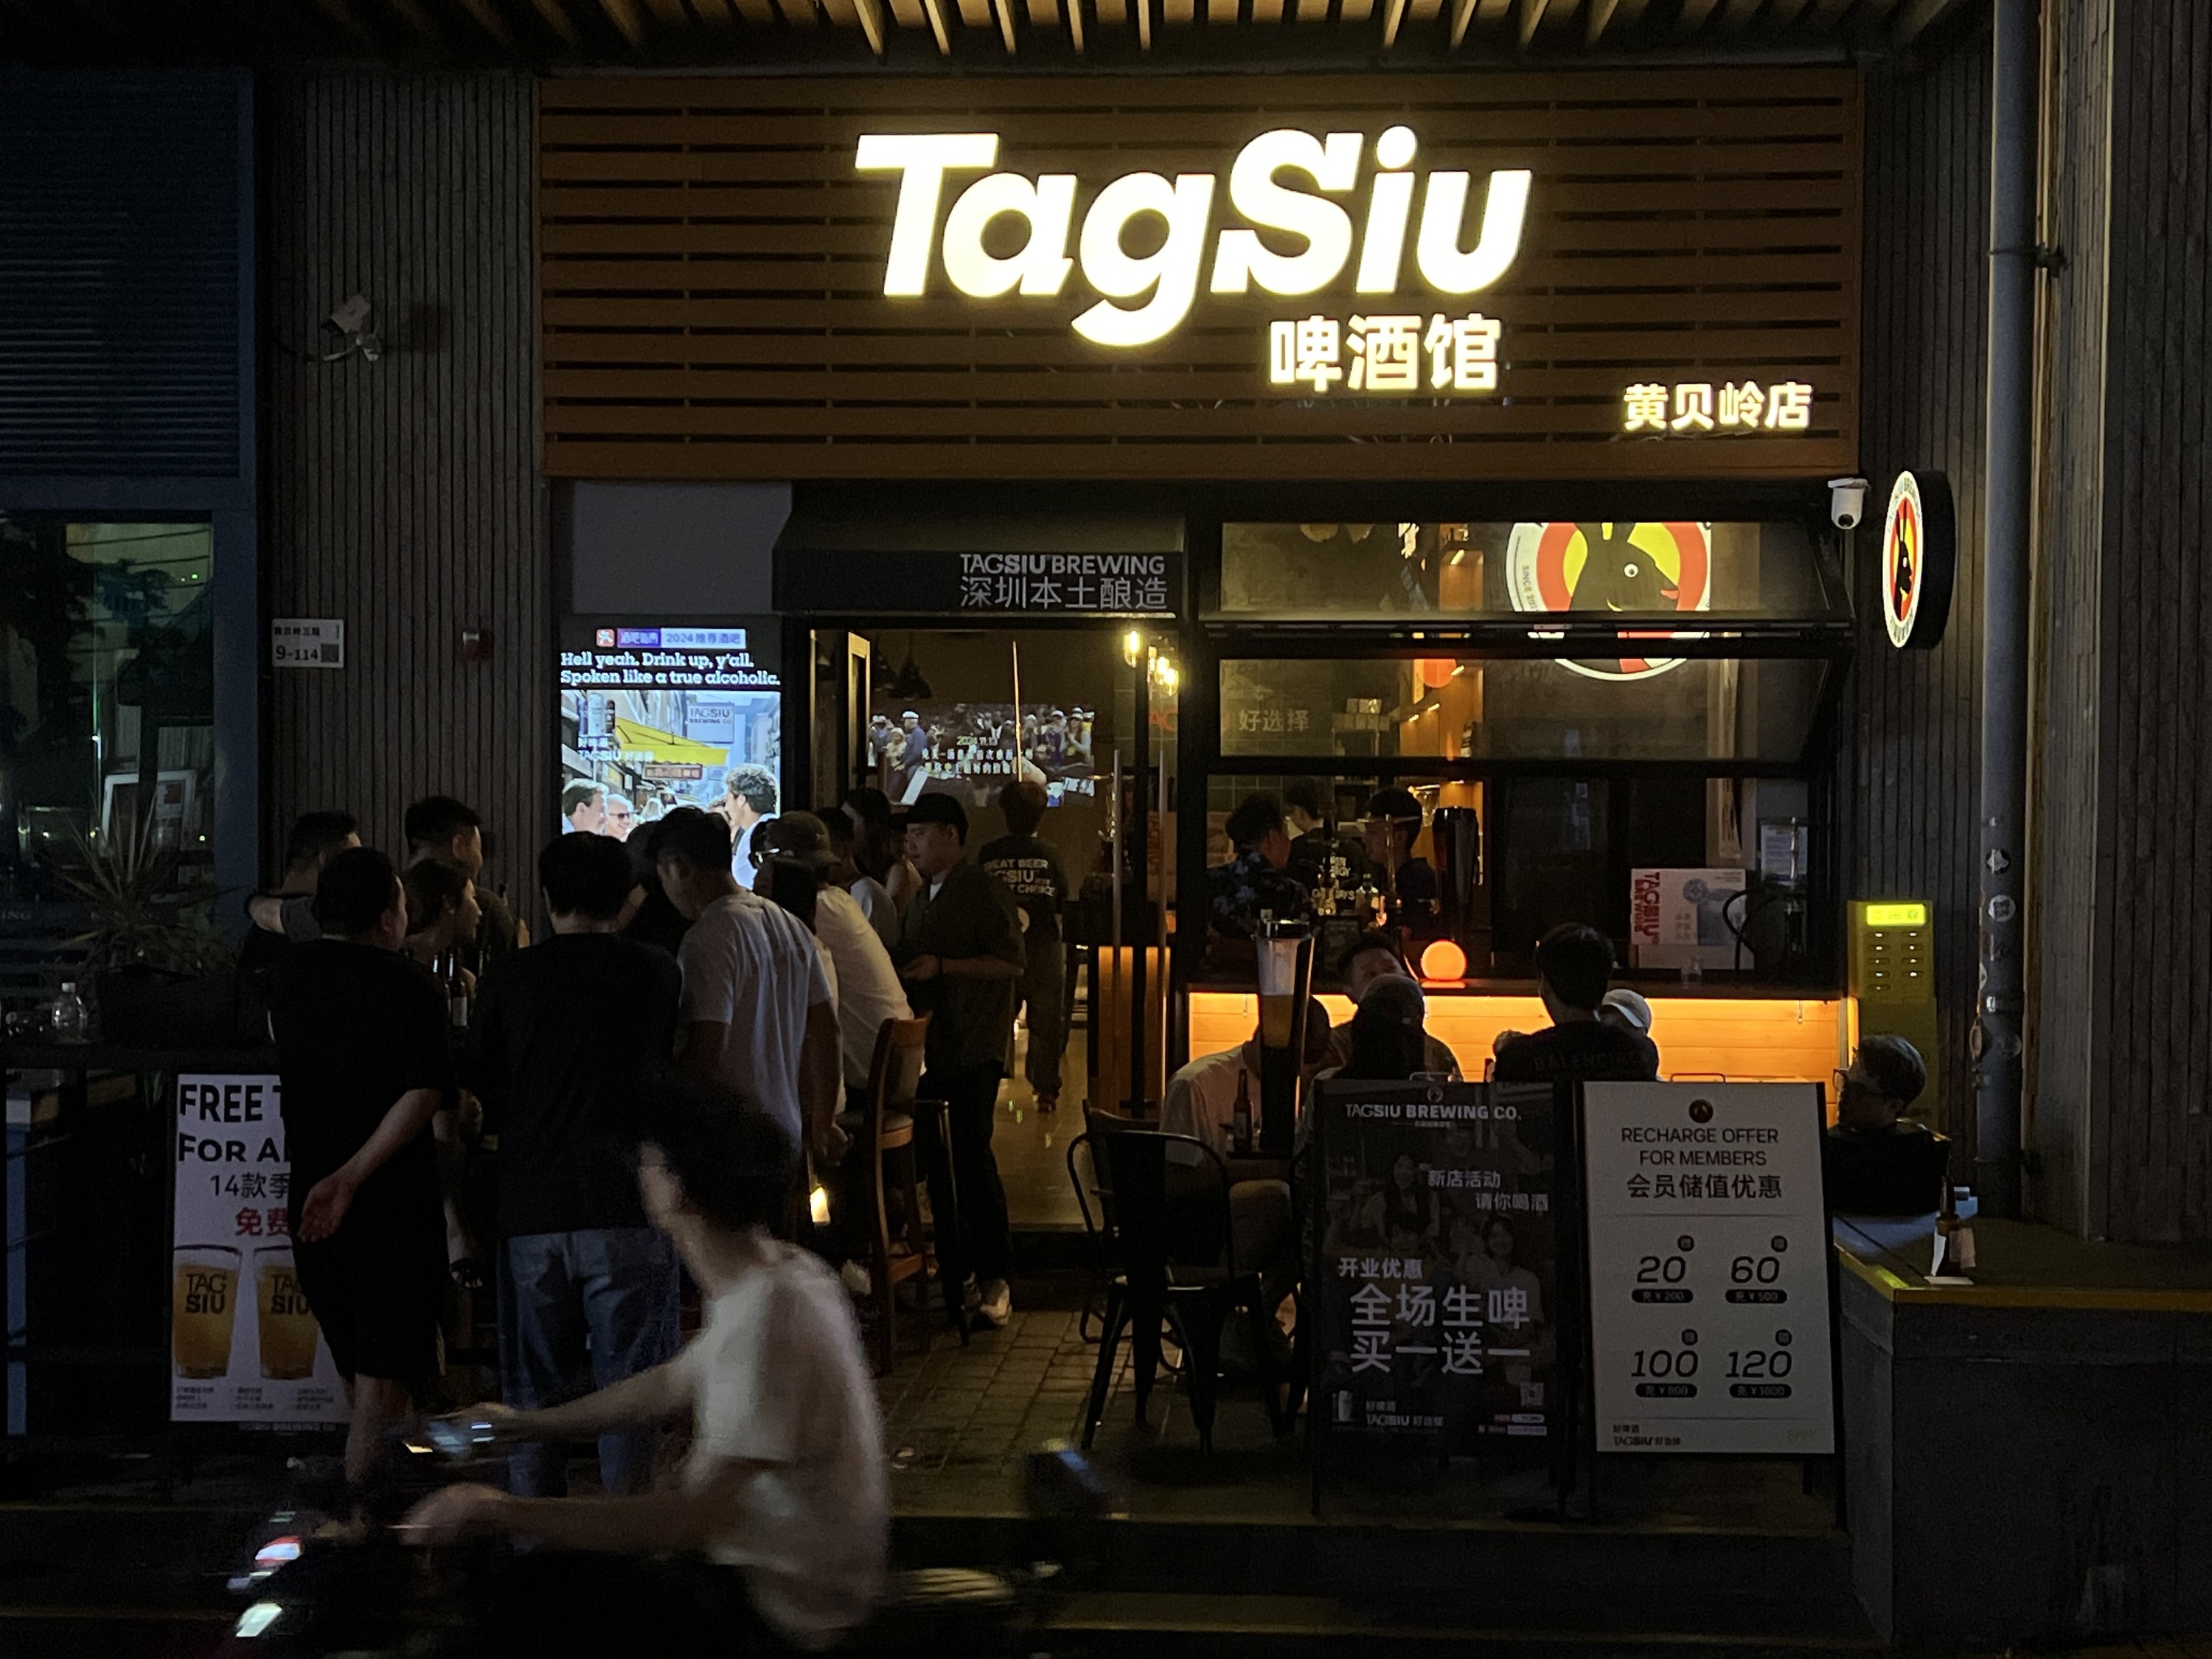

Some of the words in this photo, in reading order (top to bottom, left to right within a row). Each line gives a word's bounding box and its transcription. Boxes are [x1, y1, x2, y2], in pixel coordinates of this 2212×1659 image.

[855, 125, 1532, 347] TagSiu
[1269, 313, 1501, 392] 啤酒馆
[1624, 380, 1812, 431] 黄贝岭店
[960, 554, 1046, 574] TAGSIU
[1051, 555, 1165, 574] BREWING
[960, 576, 1167, 610] 深圳本土酿造
[276, 645, 319, 660] 9-114
[560, 652, 592, 666] Hell
[595, 652, 640, 669] yeah.
[642, 652, 686, 667] Drink
[688, 654, 713, 669] up,
[560, 669, 620, 686] Spoken
[623, 669, 653, 684] like
[655, 672, 666, 684] a
[669, 670, 701, 684] true
[705, 671, 781, 685] alcoholic.
[1239, 709, 1310, 732] 好选择
[180, 1084, 263, 1123] FREE
[1345, 1104, 1400, 1119] TAGSIU
[1406, 1105, 1489, 1120] BREWING
[178, 1133, 246, 1162] FOR
[1622, 1128, 1717, 1143] RECHARGE
[1722, 1129, 1778, 1143] OFFER
[1640, 1150, 1674, 1165] FOR
[1680, 1151, 1767, 1166] MEMBERS
[1427, 1169, 1501, 1188] 新店活动
[1627, 1174, 1781, 1199] 会员储值优惠
[1475, 1192, 1549, 1212] 请你喝酒
[235, 1207, 291, 1237] 免费
[1338, 1257, 1422, 1279] 开业优惠
[1637, 1256, 1686, 1283] 20
[1731, 1256, 1779, 1283] 60
[187, 1273, 228, 1294] TAG
[185, 1294, 225, 1315] SIU
[1350, 1283, 1530, 1330] 全场生啤
[1350, 1330, 1530, 1374] 买一送一
[1632, 1350, 1698, 1377] 100
[1726, 1351, 1792, 1377] 120
